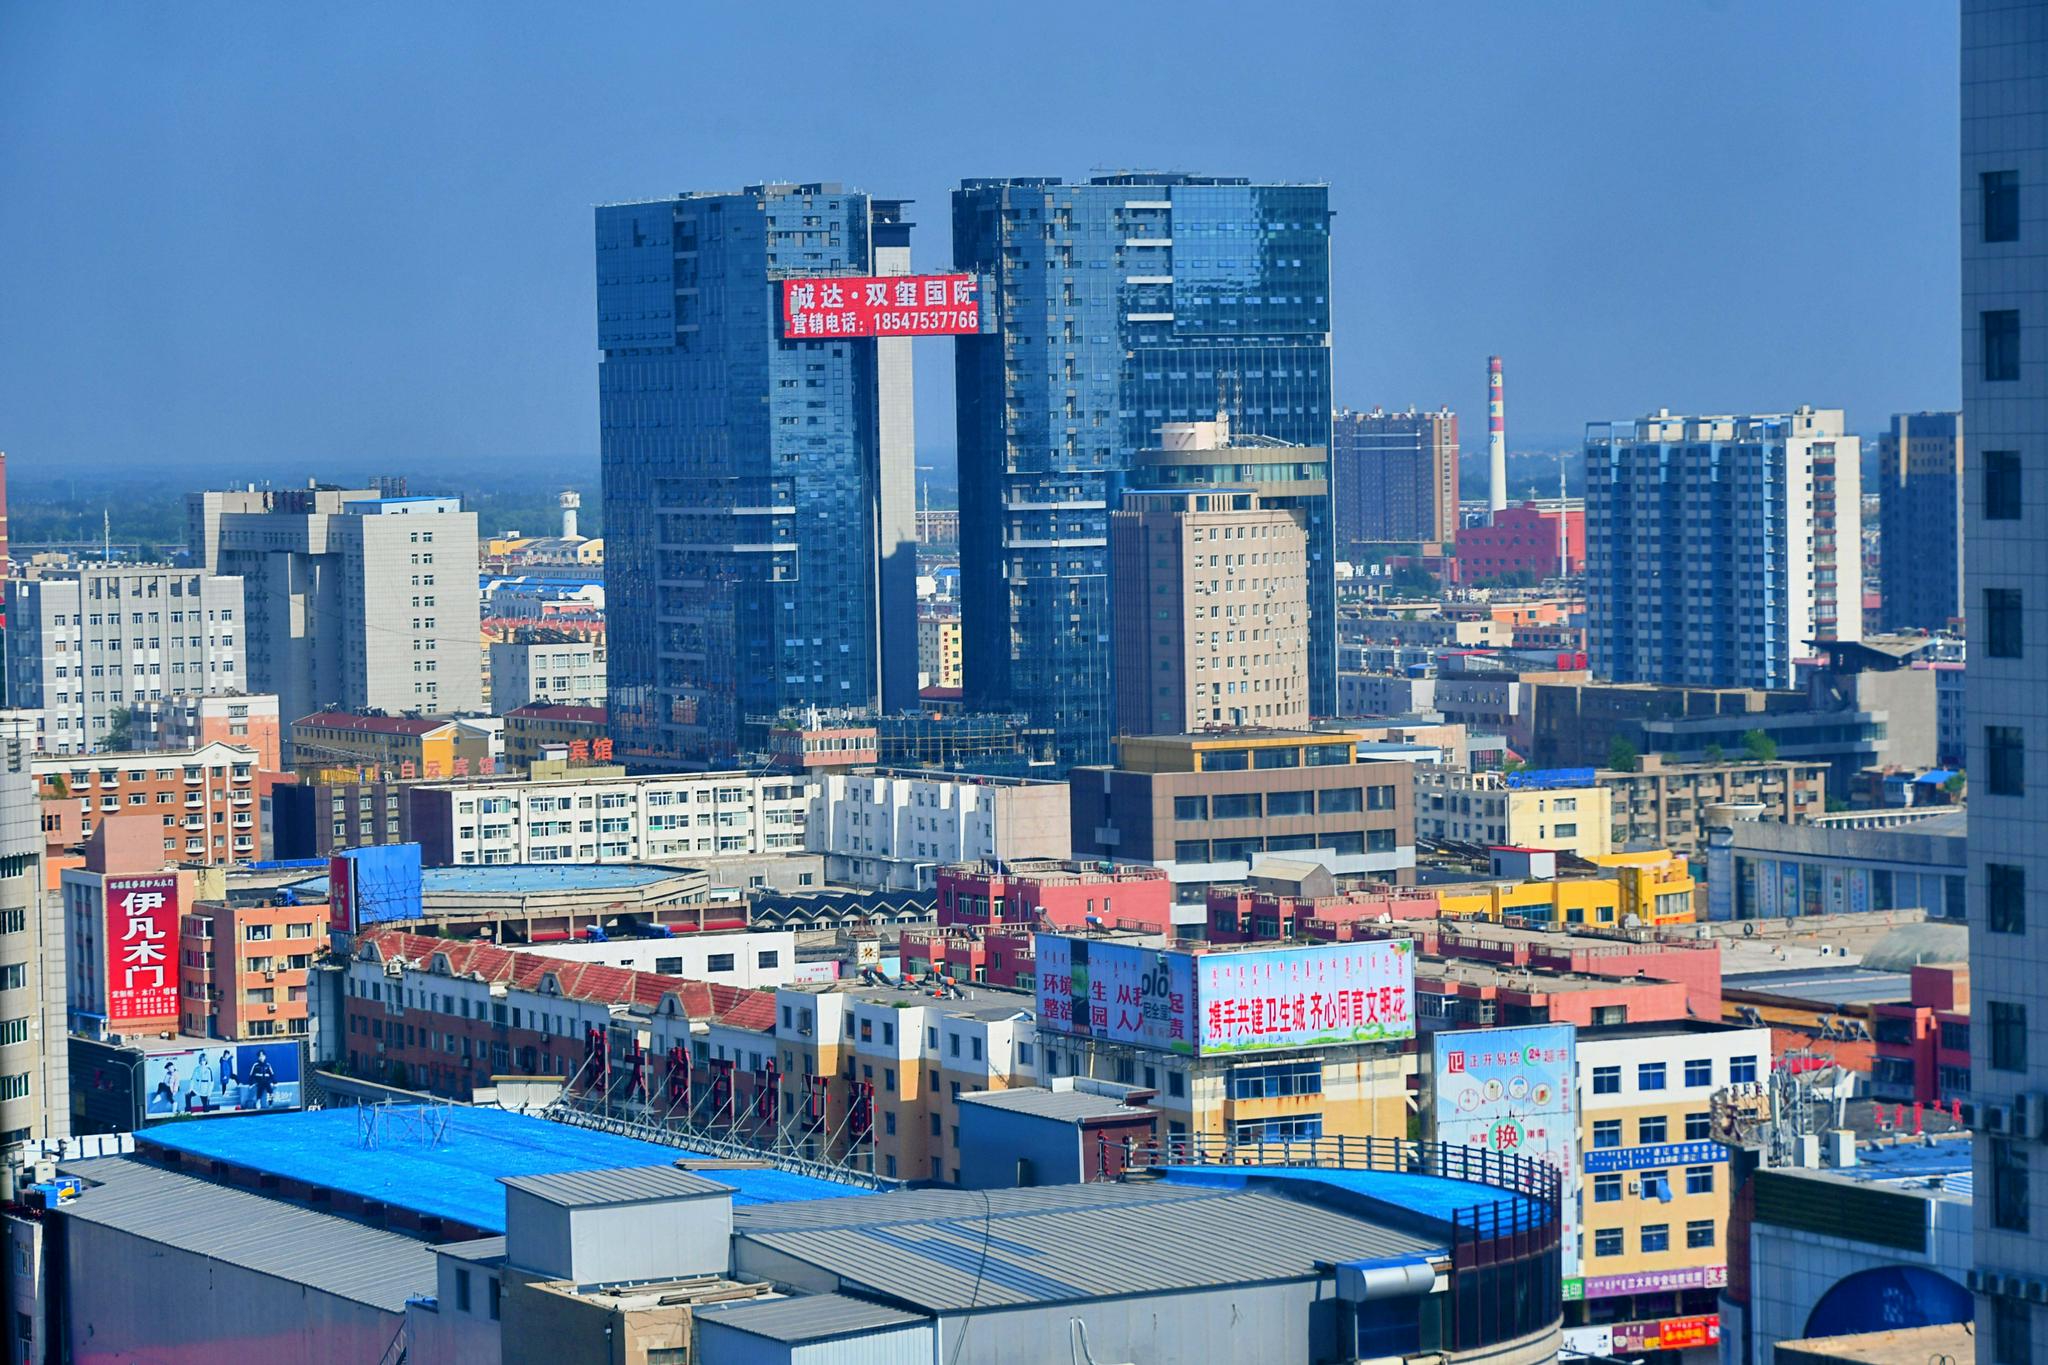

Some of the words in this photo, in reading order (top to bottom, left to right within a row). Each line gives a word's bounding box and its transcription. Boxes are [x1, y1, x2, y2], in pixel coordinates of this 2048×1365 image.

[569, 737, 614, 761] 宾馆
[401, 756, 496, 779] 白云宾馆
[120, 892, 167, 988] 伊凡木门
[1208, 992, 1306, 1039] 携手共建卫生城
[1310, 984, 1408, 1031] 齐心同育文明花
[1495, 1124, 1518, 1149] 换
